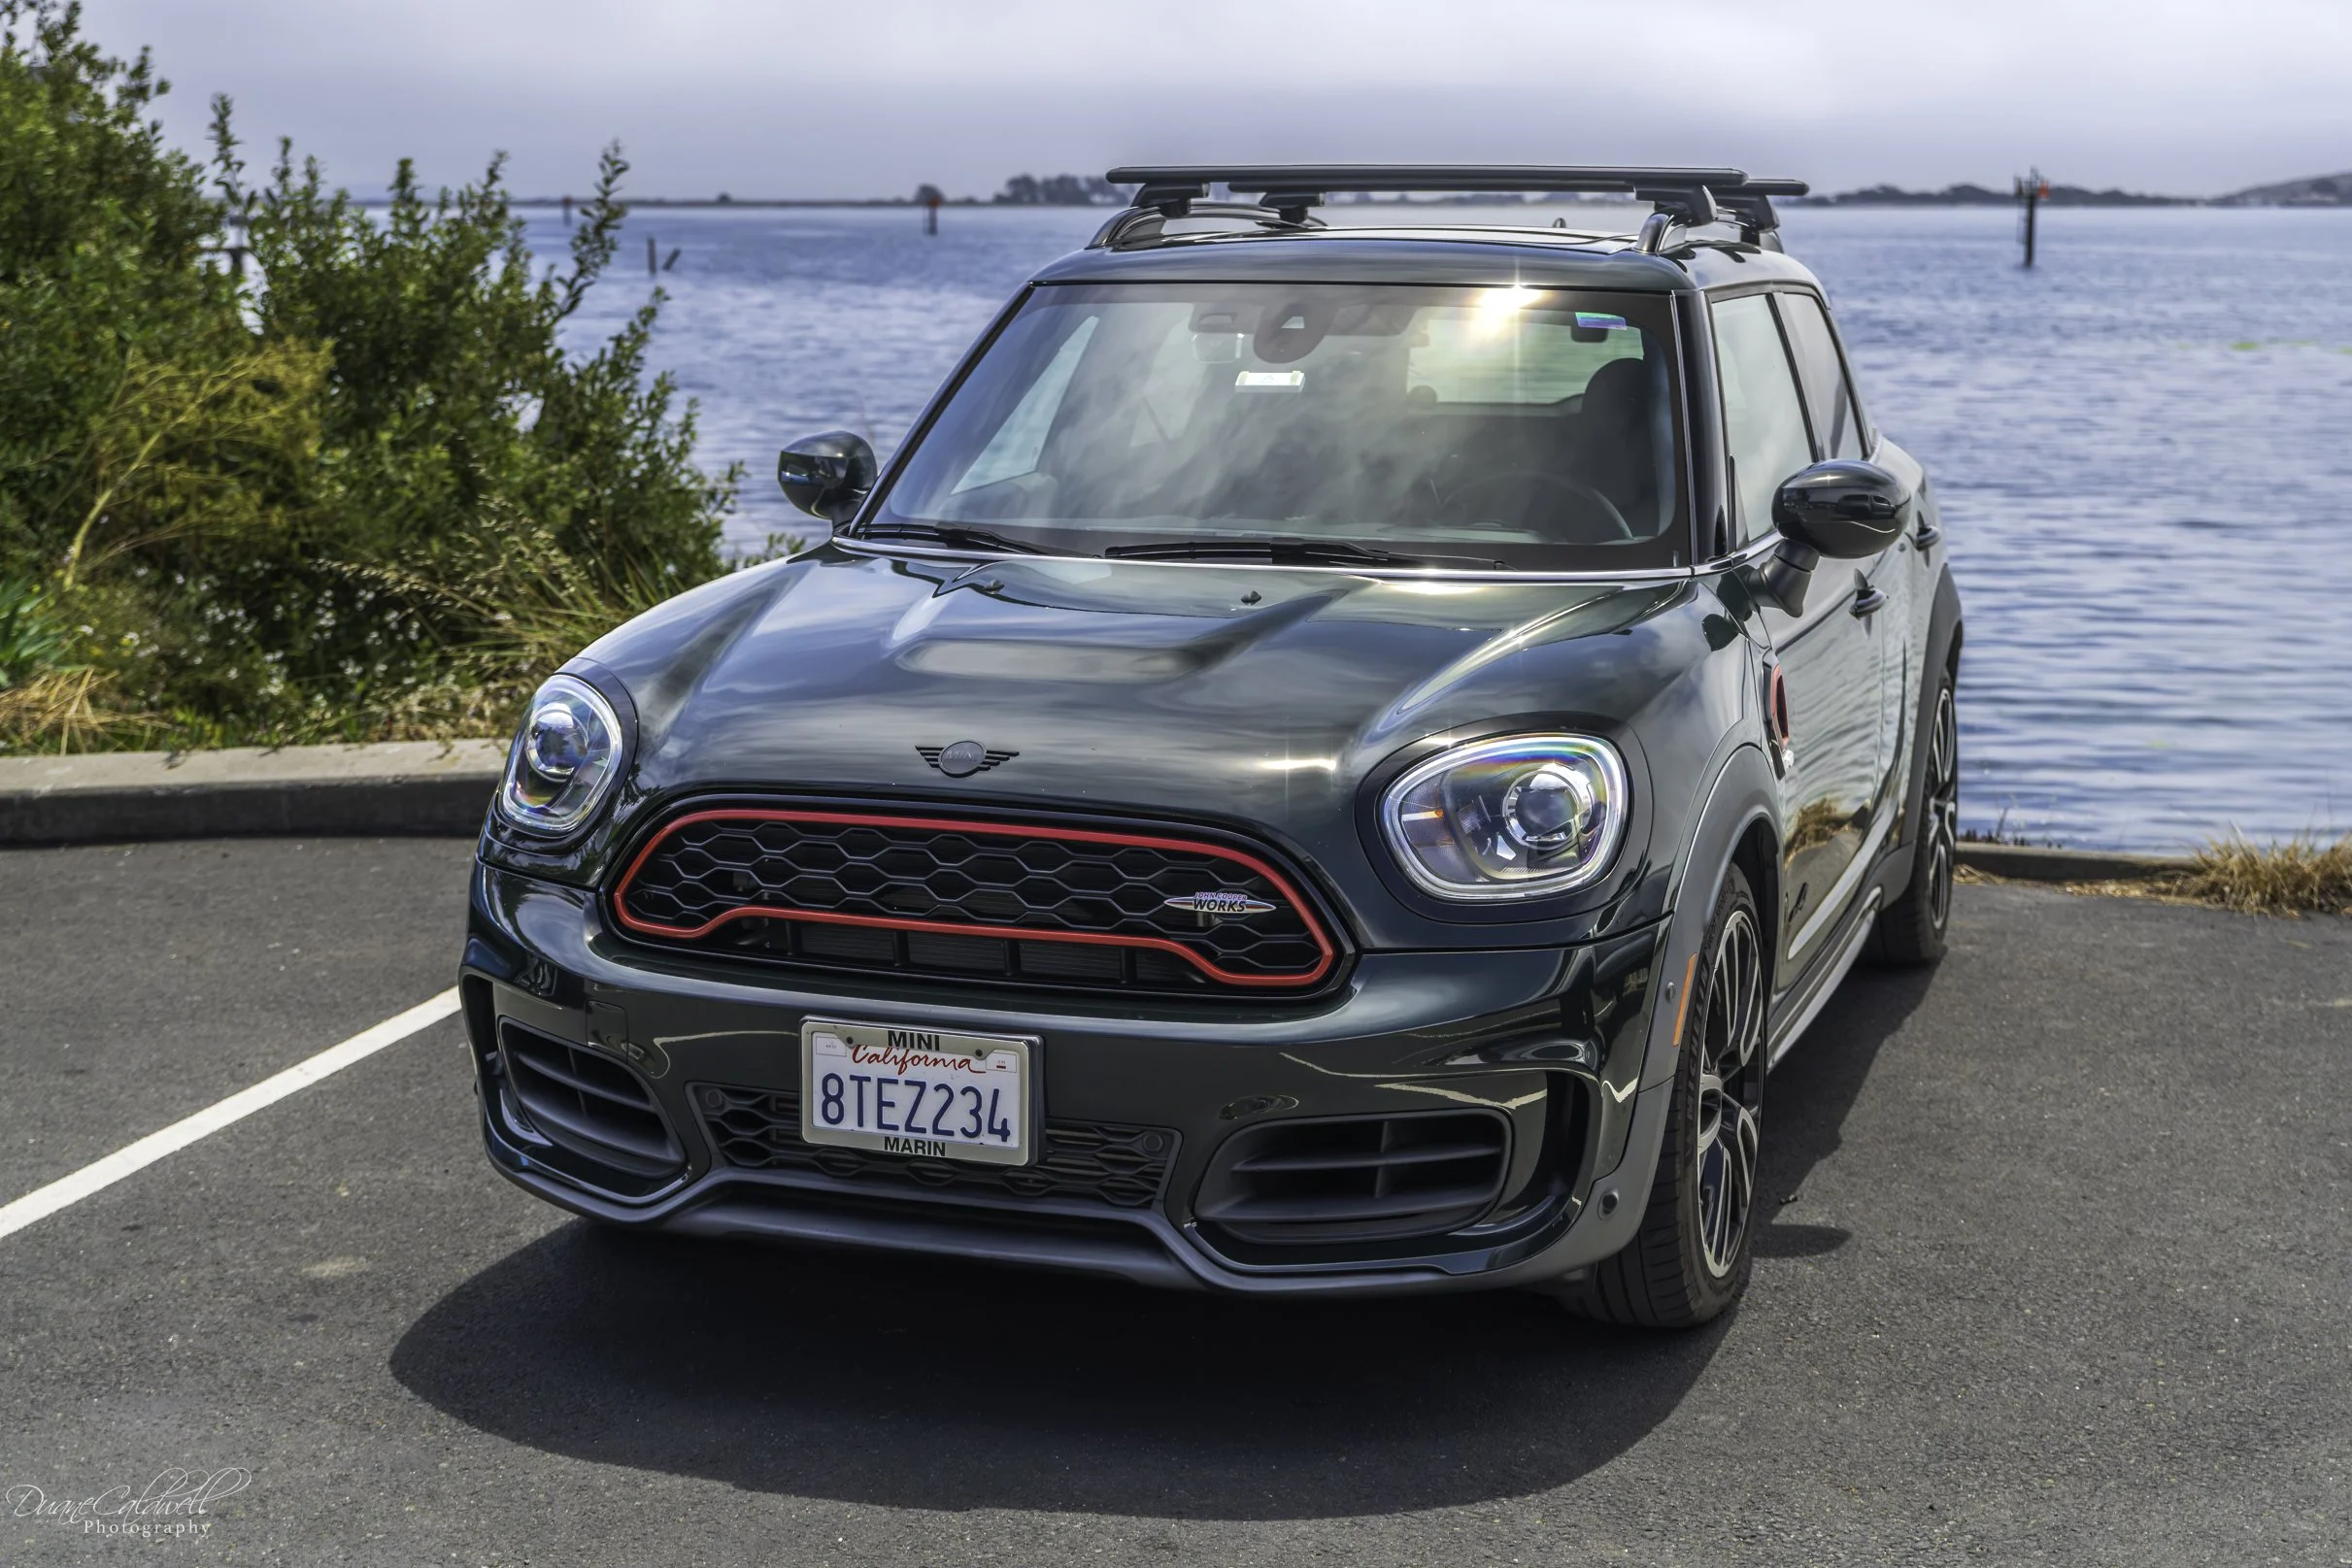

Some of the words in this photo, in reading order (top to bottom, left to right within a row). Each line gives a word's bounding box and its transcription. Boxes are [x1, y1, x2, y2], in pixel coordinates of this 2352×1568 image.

[1193, 899, 1247, 913] WORKS
[887, 1030, 941, 1051] MINI
[1687, 962, 1709, 1120] MICHELIN
[852, 1044, 987, 1076] California
[821, 1072, 1011, 1143] 8TEZ234
[884, 1136, 946, 1157] MARIN
